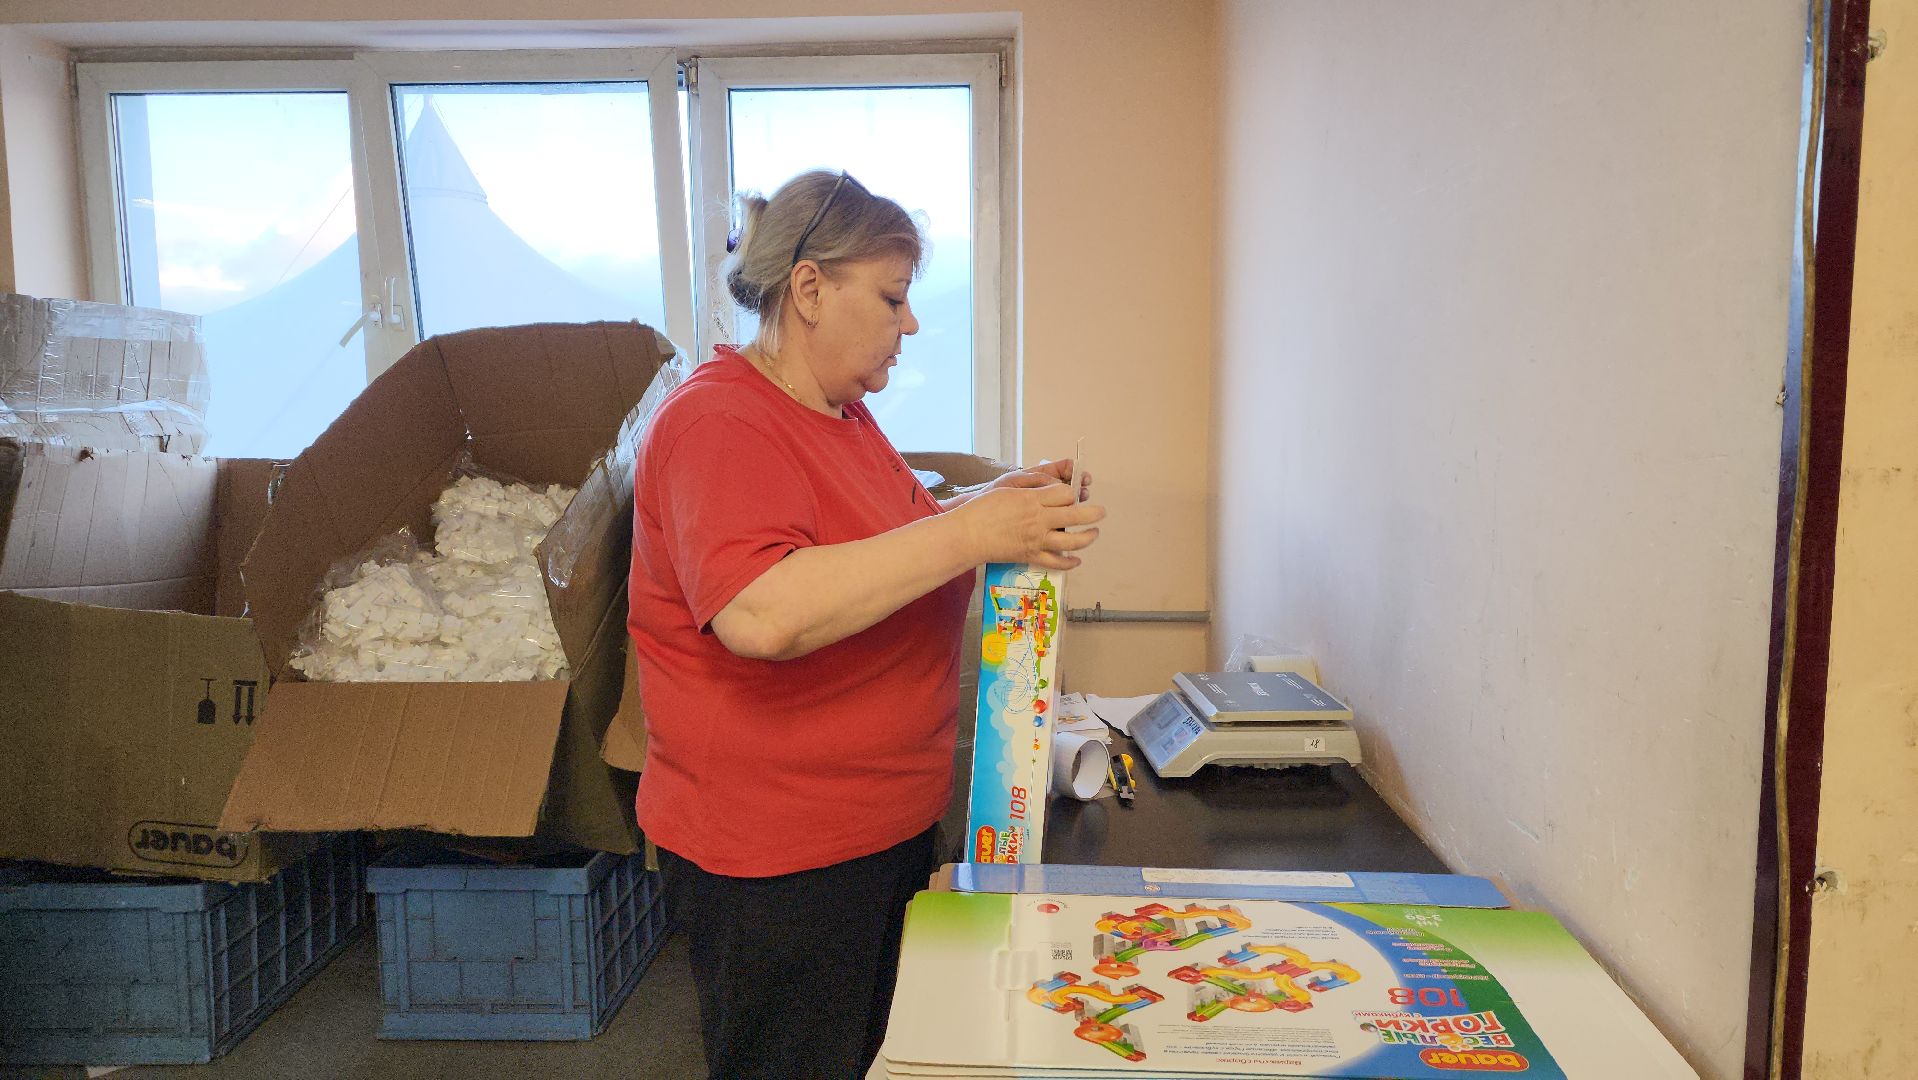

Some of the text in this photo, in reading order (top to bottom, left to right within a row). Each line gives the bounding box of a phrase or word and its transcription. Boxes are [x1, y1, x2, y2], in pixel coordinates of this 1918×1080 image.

[1009, 785, 1027, 820] 108
[135, 828, 238, 860] bauer
[980, 828, 993, 863] auer
[1387, 987, 1467, 1007] 108
[1375, 1011, 1502, 1034] ГОРКИ
[1428, 1050, 1522, 1068] bauer
